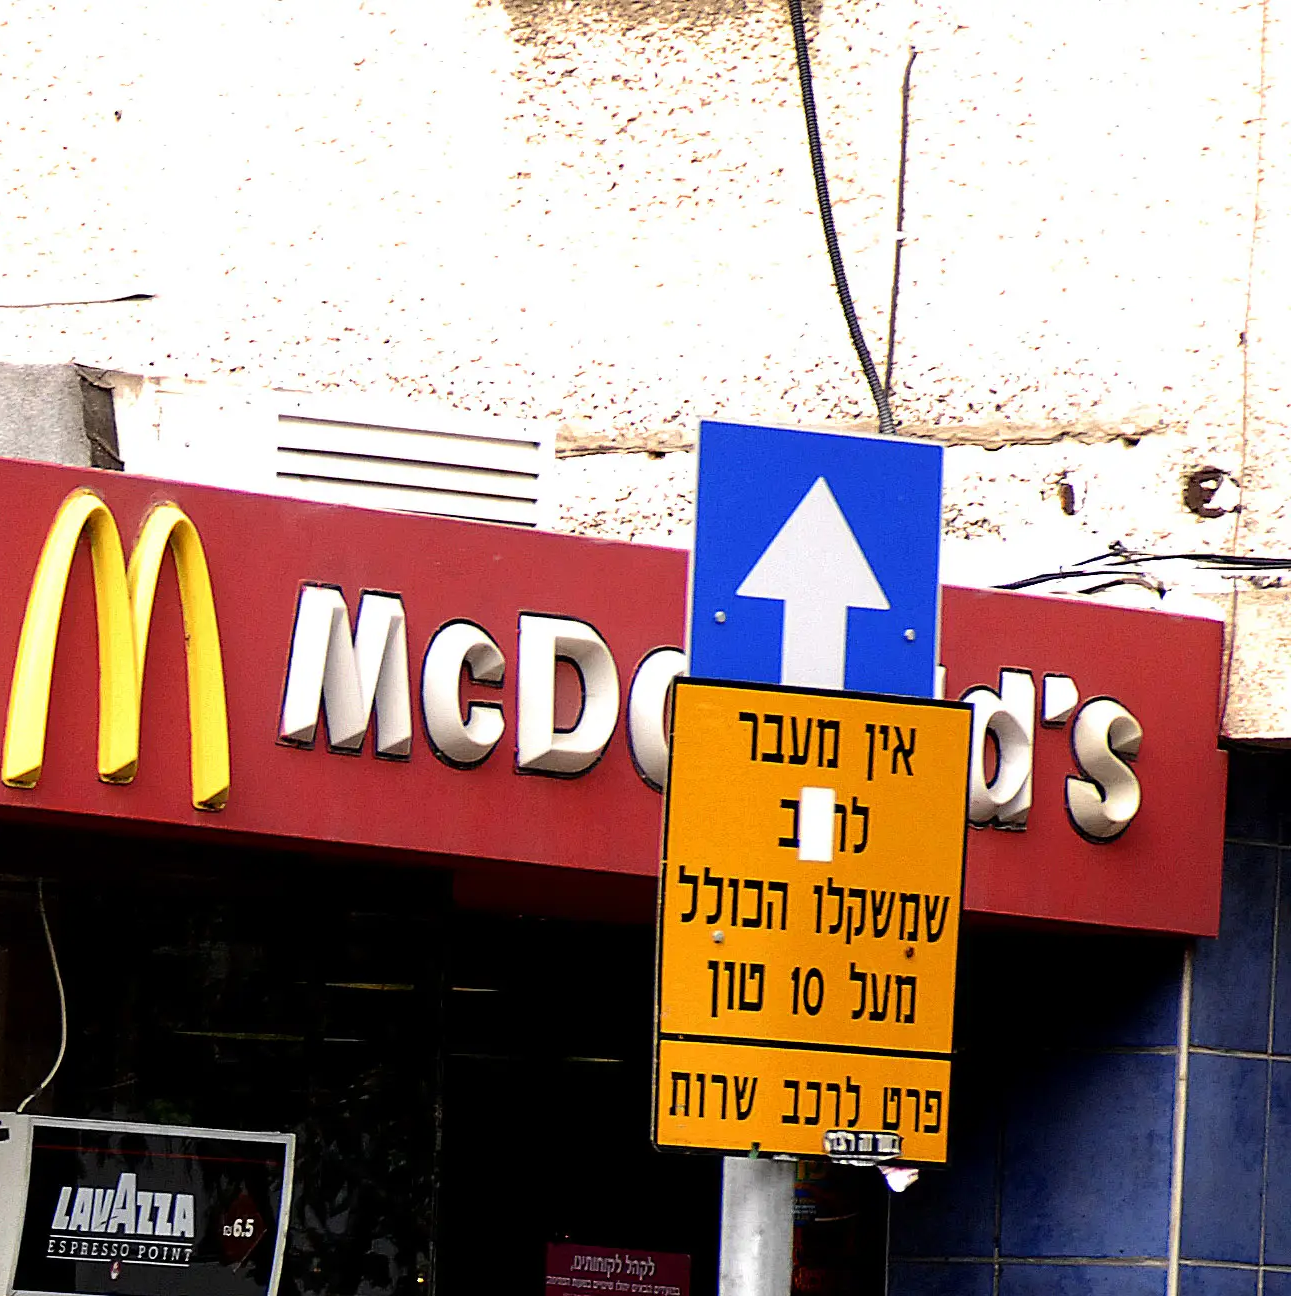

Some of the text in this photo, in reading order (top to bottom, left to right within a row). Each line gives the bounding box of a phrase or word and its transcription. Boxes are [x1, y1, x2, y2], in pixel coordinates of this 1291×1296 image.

[277, 579, 1144, 845] McDd's
[738, 711, 917, 781] אין מעבר
[777, 796, 870, 854] לרב
[678, 864, 951, 945] שמשקלו הכולל
[707, 959, 917, 1024] מעל 10 טון
[669, 1070, 942, 1134] פרט לרכב שרות
[50, 1172, 195, 1238] LAVAZZA
[47, 1239, 194, 1263] ESPRESSO POINT
